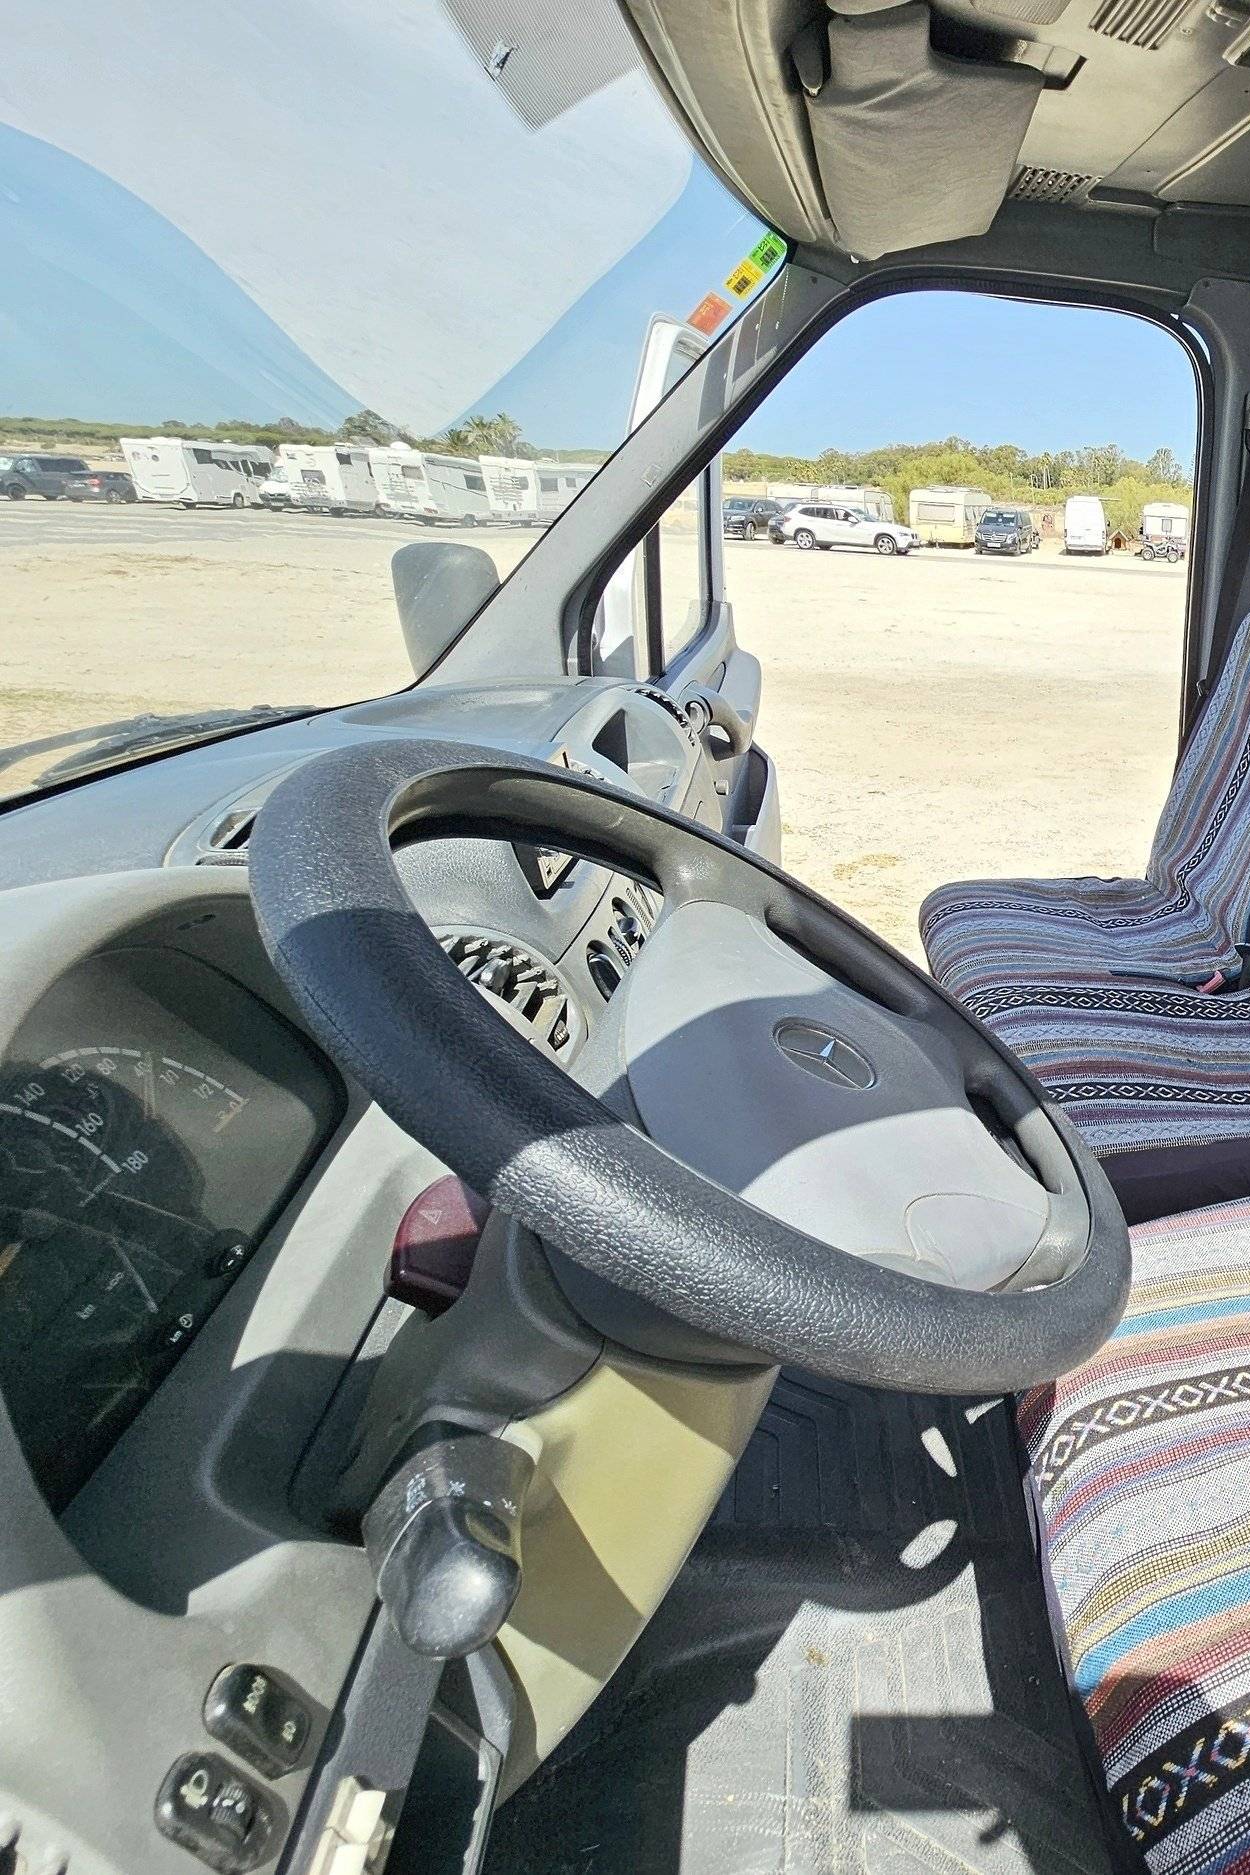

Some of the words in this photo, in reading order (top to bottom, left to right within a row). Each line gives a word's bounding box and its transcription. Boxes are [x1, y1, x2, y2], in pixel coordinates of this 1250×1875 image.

[14, 1082, 46, 1107] 140
[75, 1112, 104, 1137] 160
[121, 1150, 149, 1174] 180
